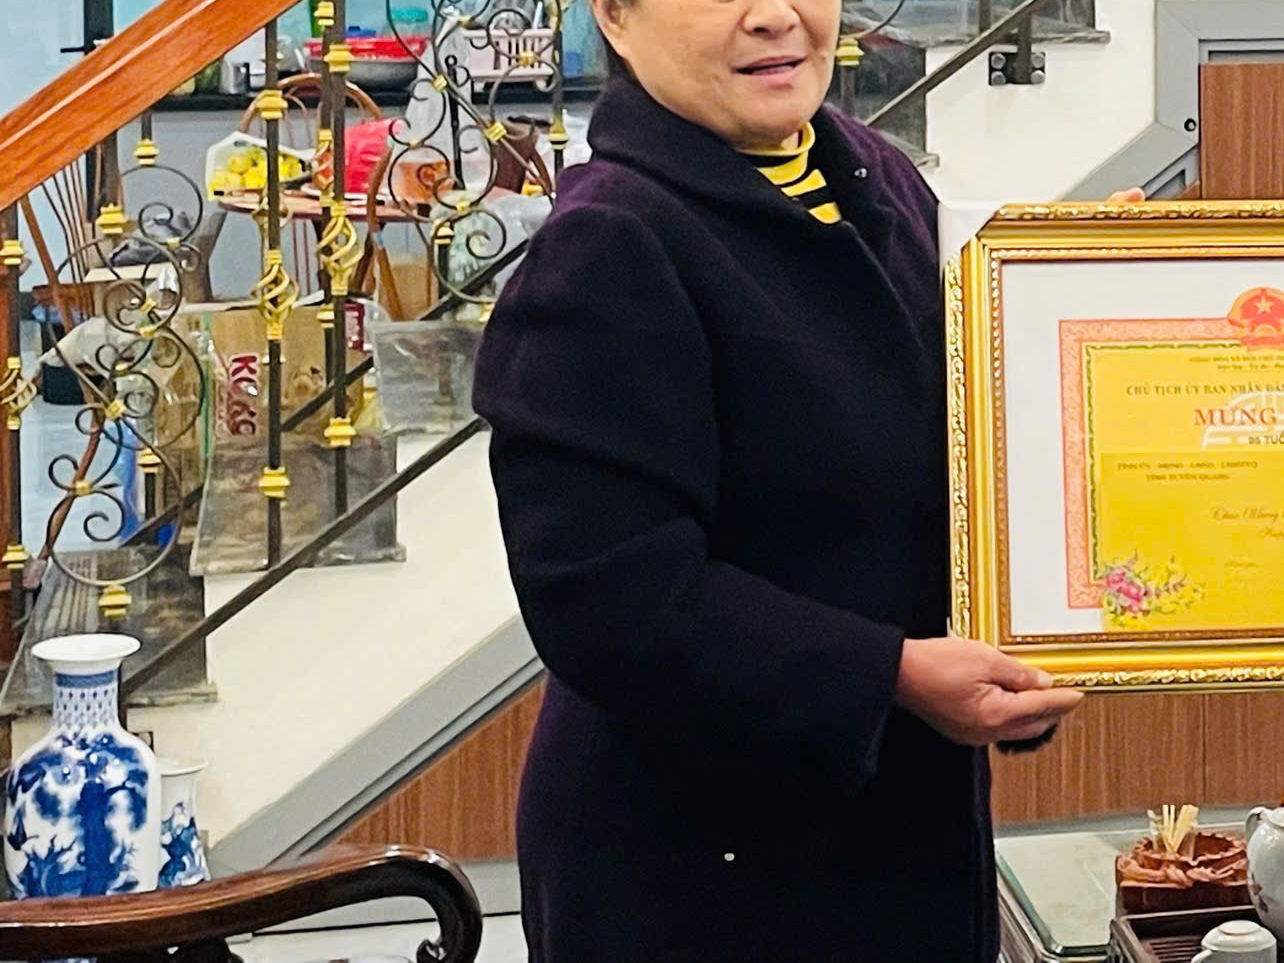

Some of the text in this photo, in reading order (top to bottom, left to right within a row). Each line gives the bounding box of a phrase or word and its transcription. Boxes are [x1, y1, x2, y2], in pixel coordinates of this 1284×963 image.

[1125, 381, 1151, 396] CHỦ
[1154, 383, 1182, 397] TỊCH
[1203, 384, 1227, 394] BAN
[1230, 380, 1262, 394] NHÂN
